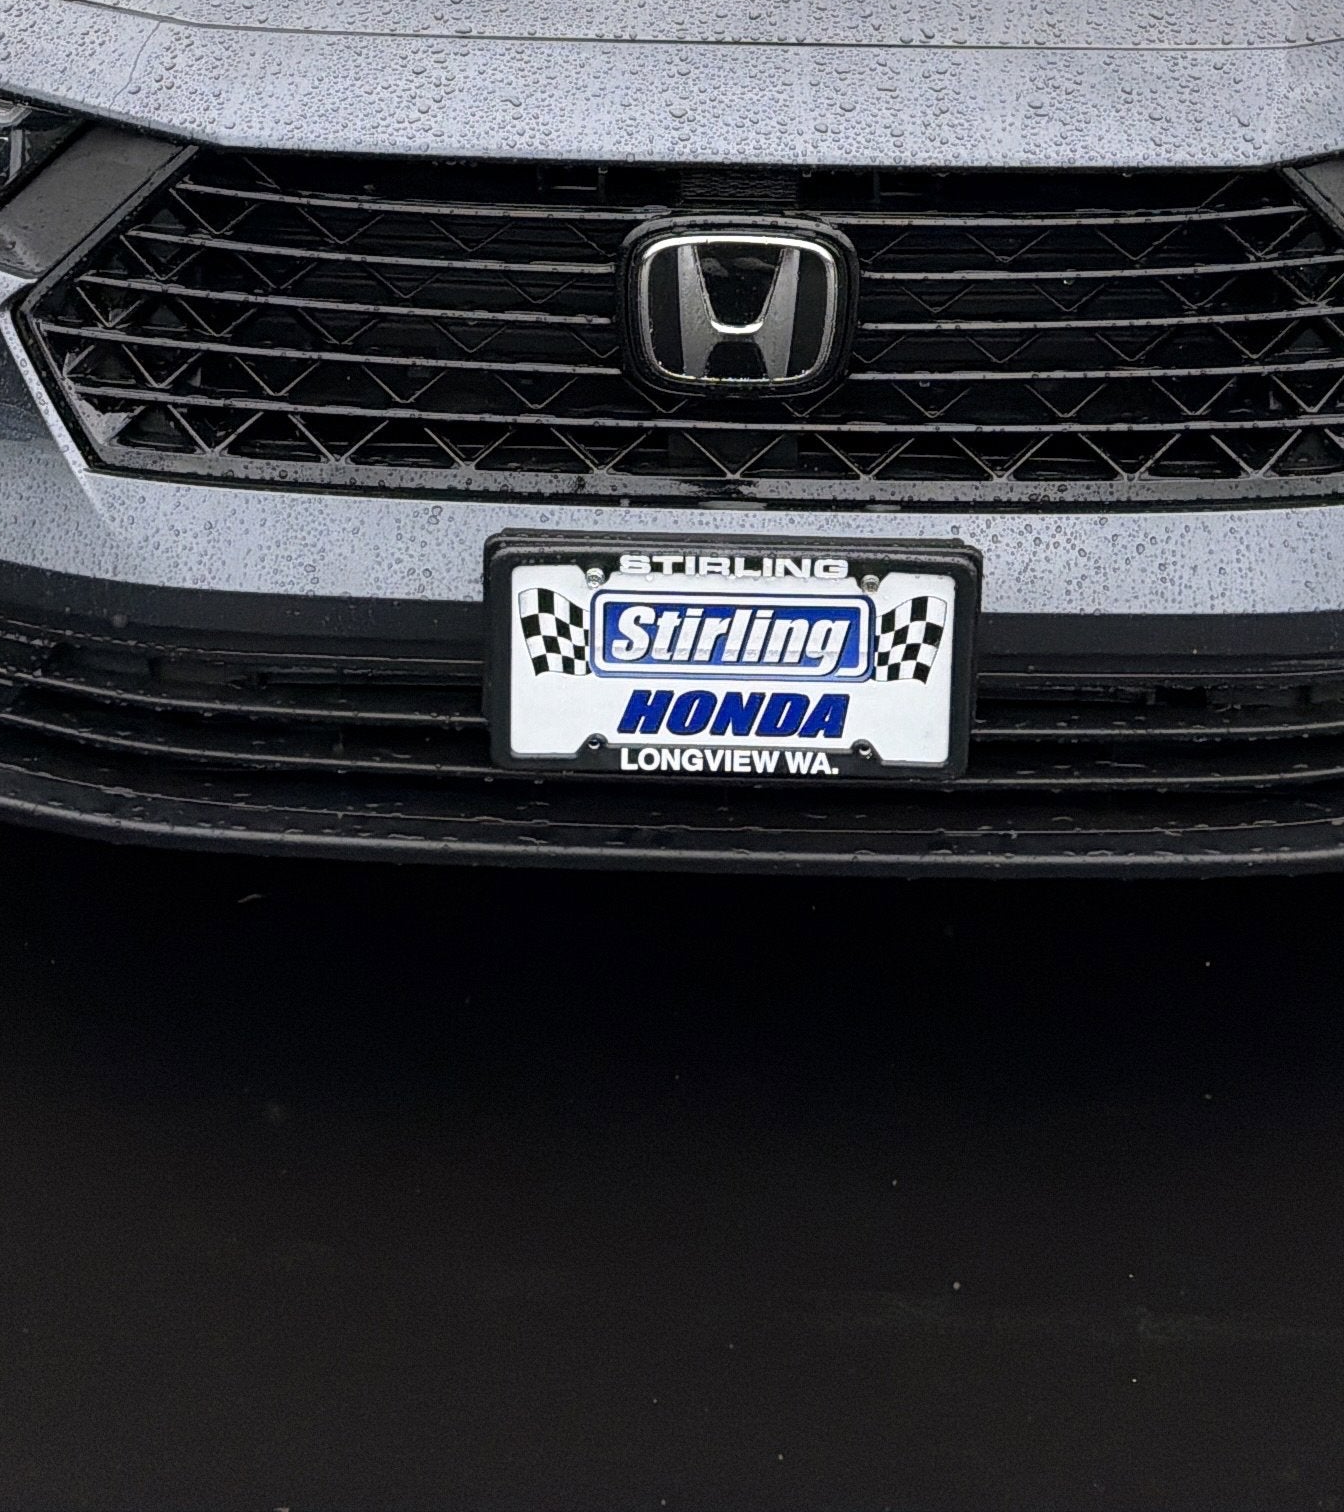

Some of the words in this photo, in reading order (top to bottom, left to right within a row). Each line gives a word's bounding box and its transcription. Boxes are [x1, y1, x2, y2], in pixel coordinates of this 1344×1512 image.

[619, 554, 849, 579] STIRLING
[611, 605, 851, 675] Stirling
[617, 689, 850, 738] HONDA
[620, 748, 780, 773] LONGVIEW
[785, 751, 840, 775] WA.
